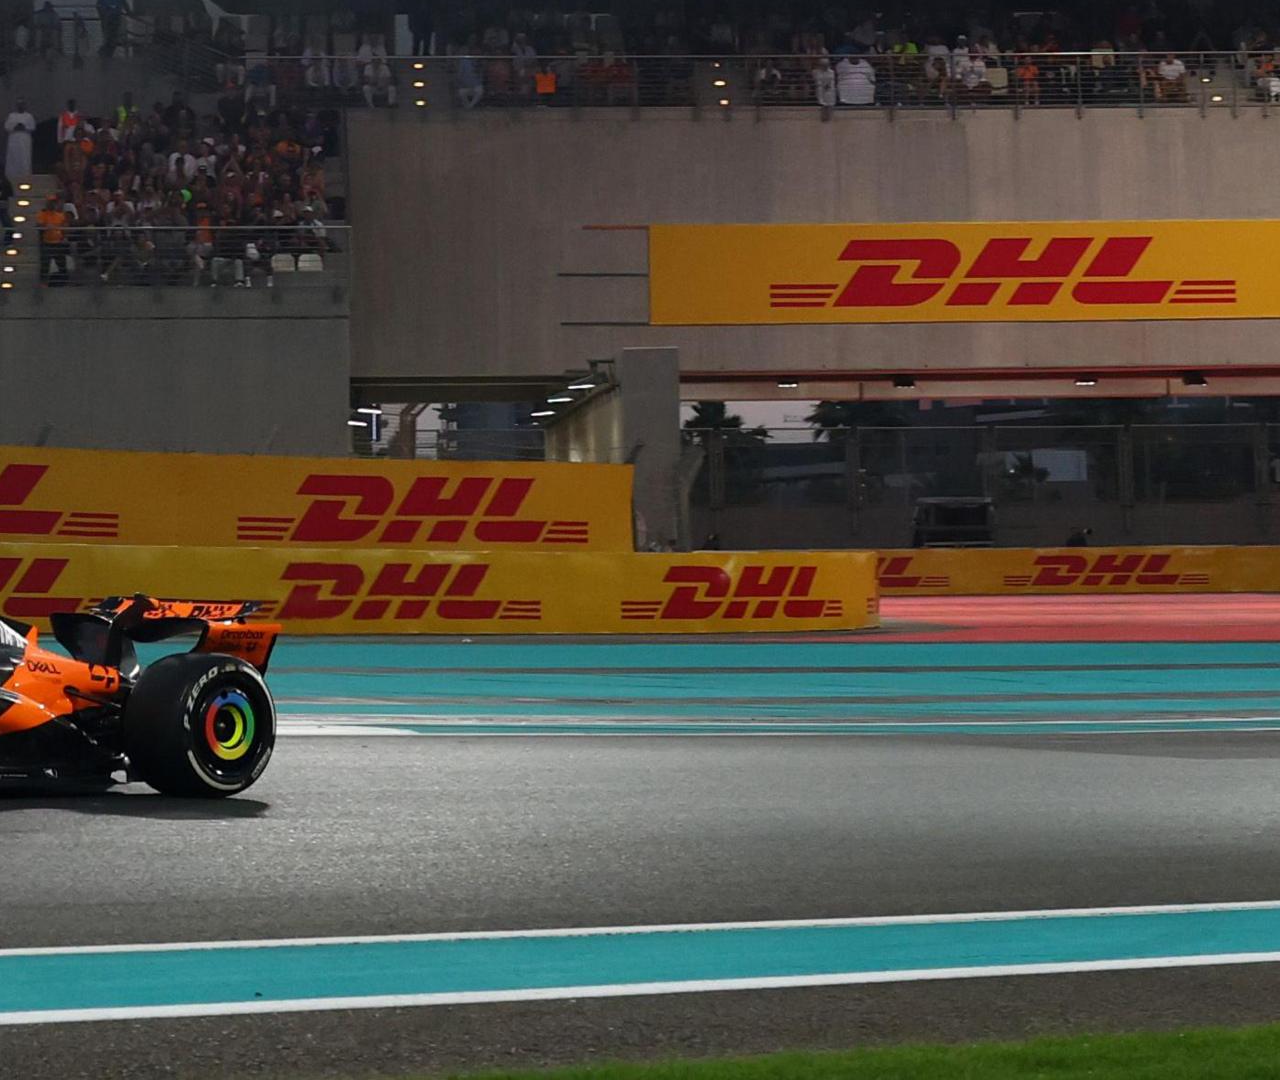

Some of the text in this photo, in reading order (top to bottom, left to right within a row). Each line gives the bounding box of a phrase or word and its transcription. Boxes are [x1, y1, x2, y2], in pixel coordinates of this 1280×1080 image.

[832, 236, 1174, 308] DHL
[289, 473, 548, 543] DHL
[274, 562, 502, 620] DHL
[660, 565, 826, 620] DHL
[1031, 554, 1180, 586] DHL
[186, 666, 218, 713] ZERO
